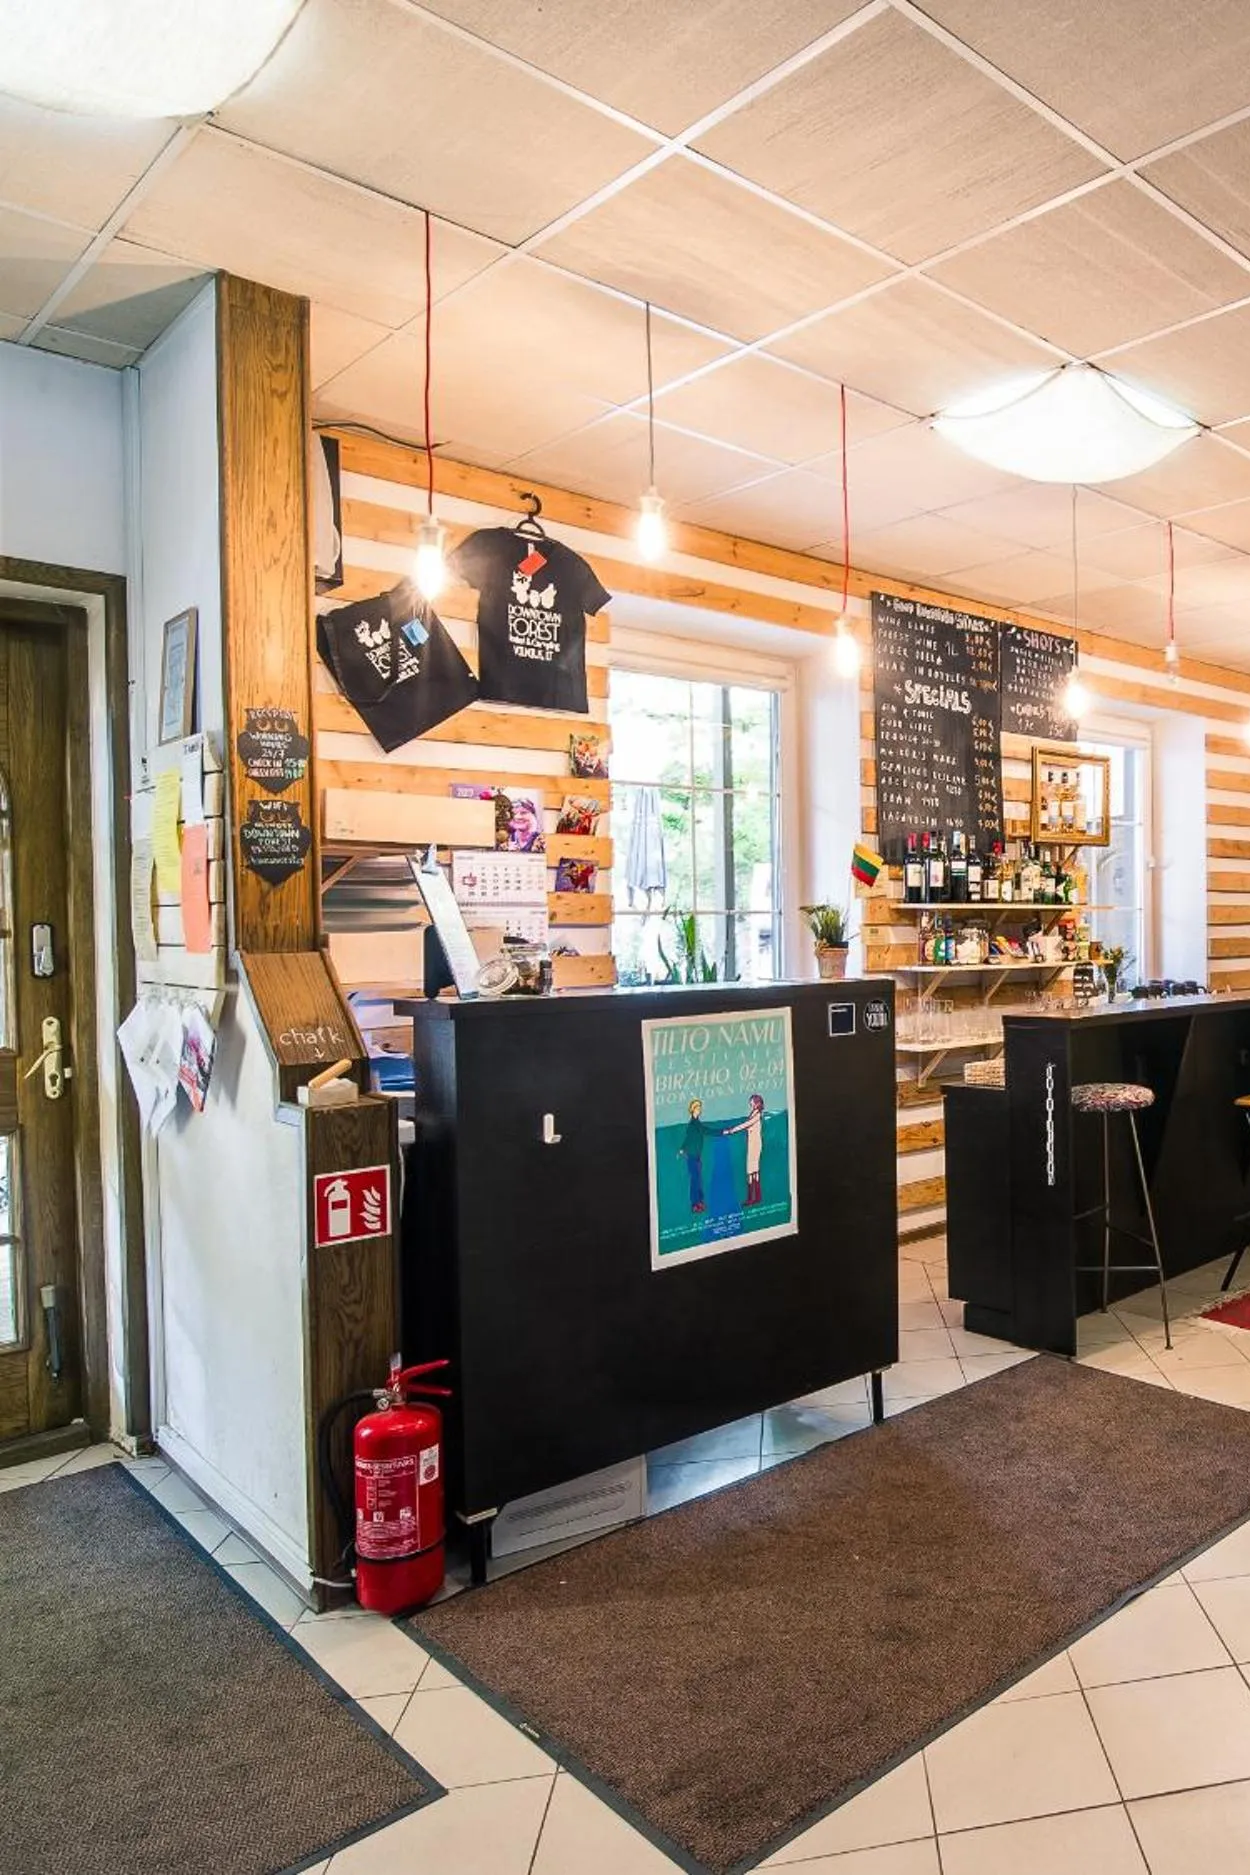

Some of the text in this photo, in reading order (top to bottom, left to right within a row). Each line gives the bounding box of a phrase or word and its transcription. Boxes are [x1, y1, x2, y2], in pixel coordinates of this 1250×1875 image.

[508, 603, 562, 623] DOWNTOWN
[508, 614, 561, 642] FOREST
[1022, 629, 1061, 655] SHOTS
[261, 748, 285, 759] 24/7
[279, 1026, 345, 1046] chalk
[652, 1026, 710, 1057] TILTO
